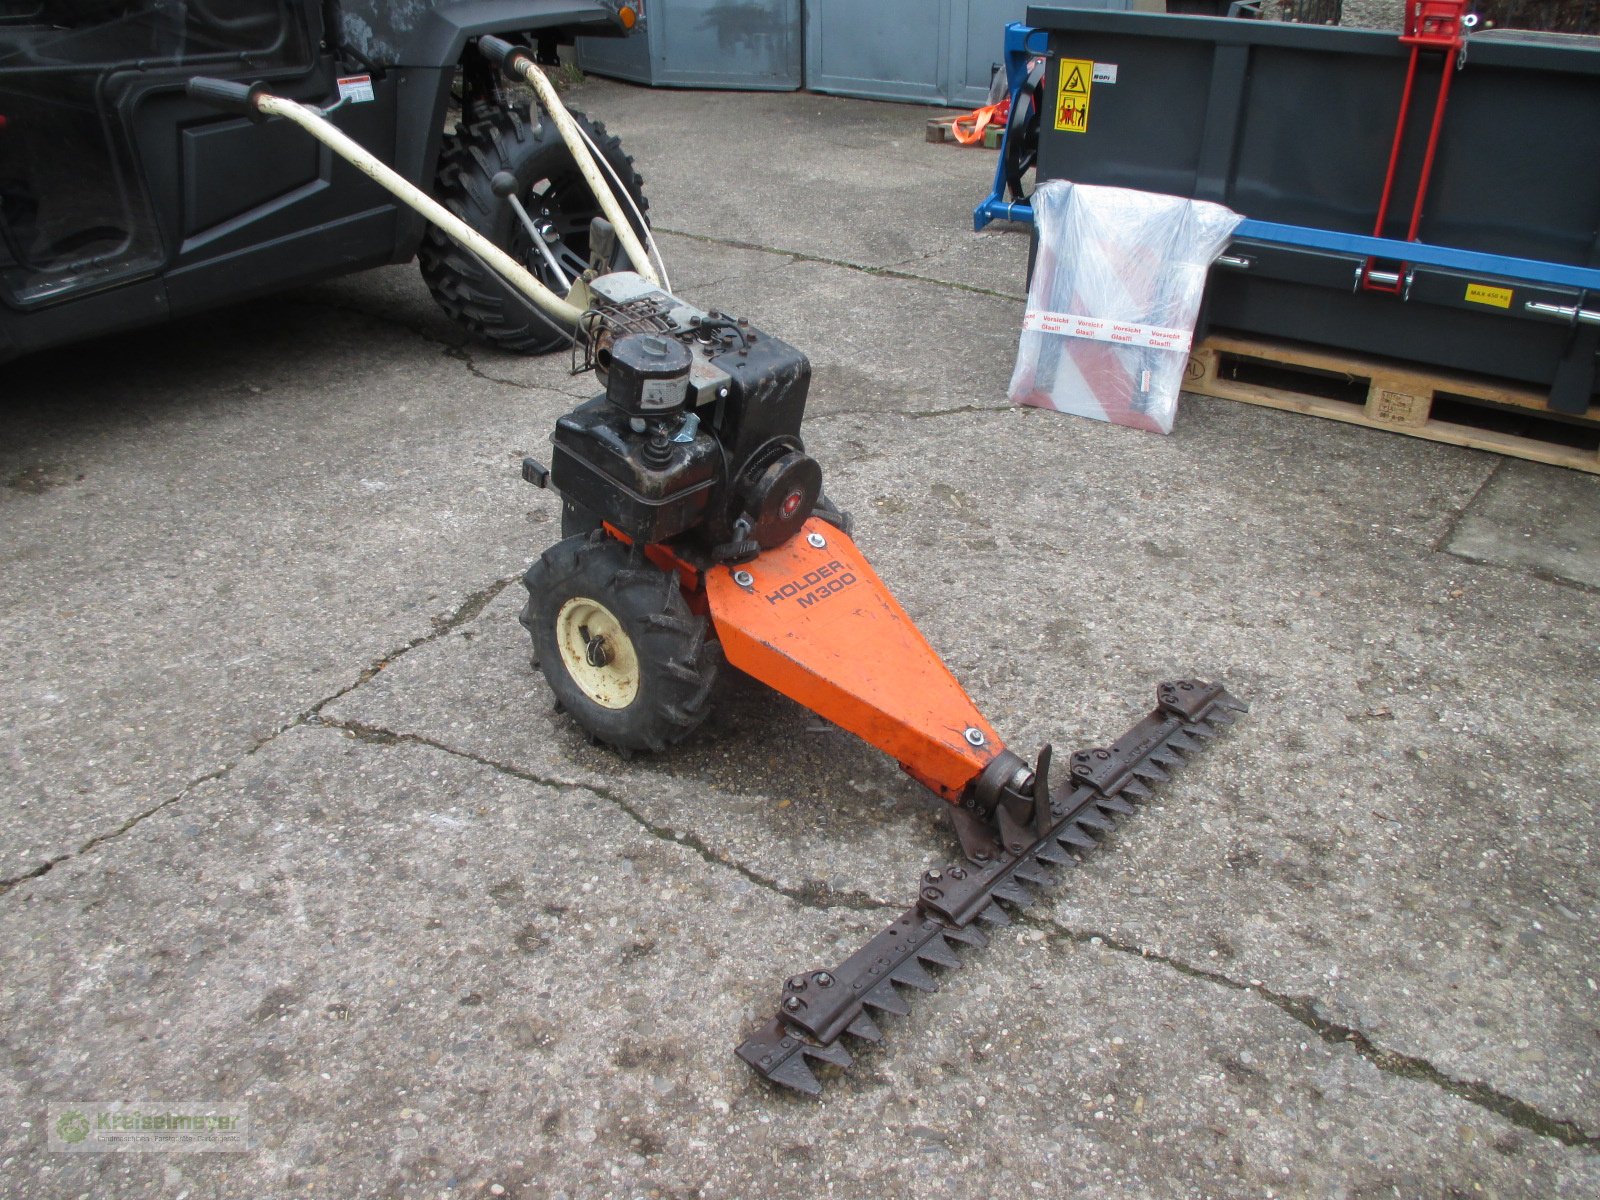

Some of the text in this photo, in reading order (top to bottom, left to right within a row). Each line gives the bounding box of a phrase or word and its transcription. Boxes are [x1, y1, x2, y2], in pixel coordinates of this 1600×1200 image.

[1043, 315, 1069, 324] Vorsicht
[1077, 320, 1104, 329] Vorsicht
[1113, 325, 1141, 334] Vorsicht
[1151, 330, 1180, 340] Vorsicht
[764, 560, 845, 605] HOLDER
[796, 572, 857, 609] M300
